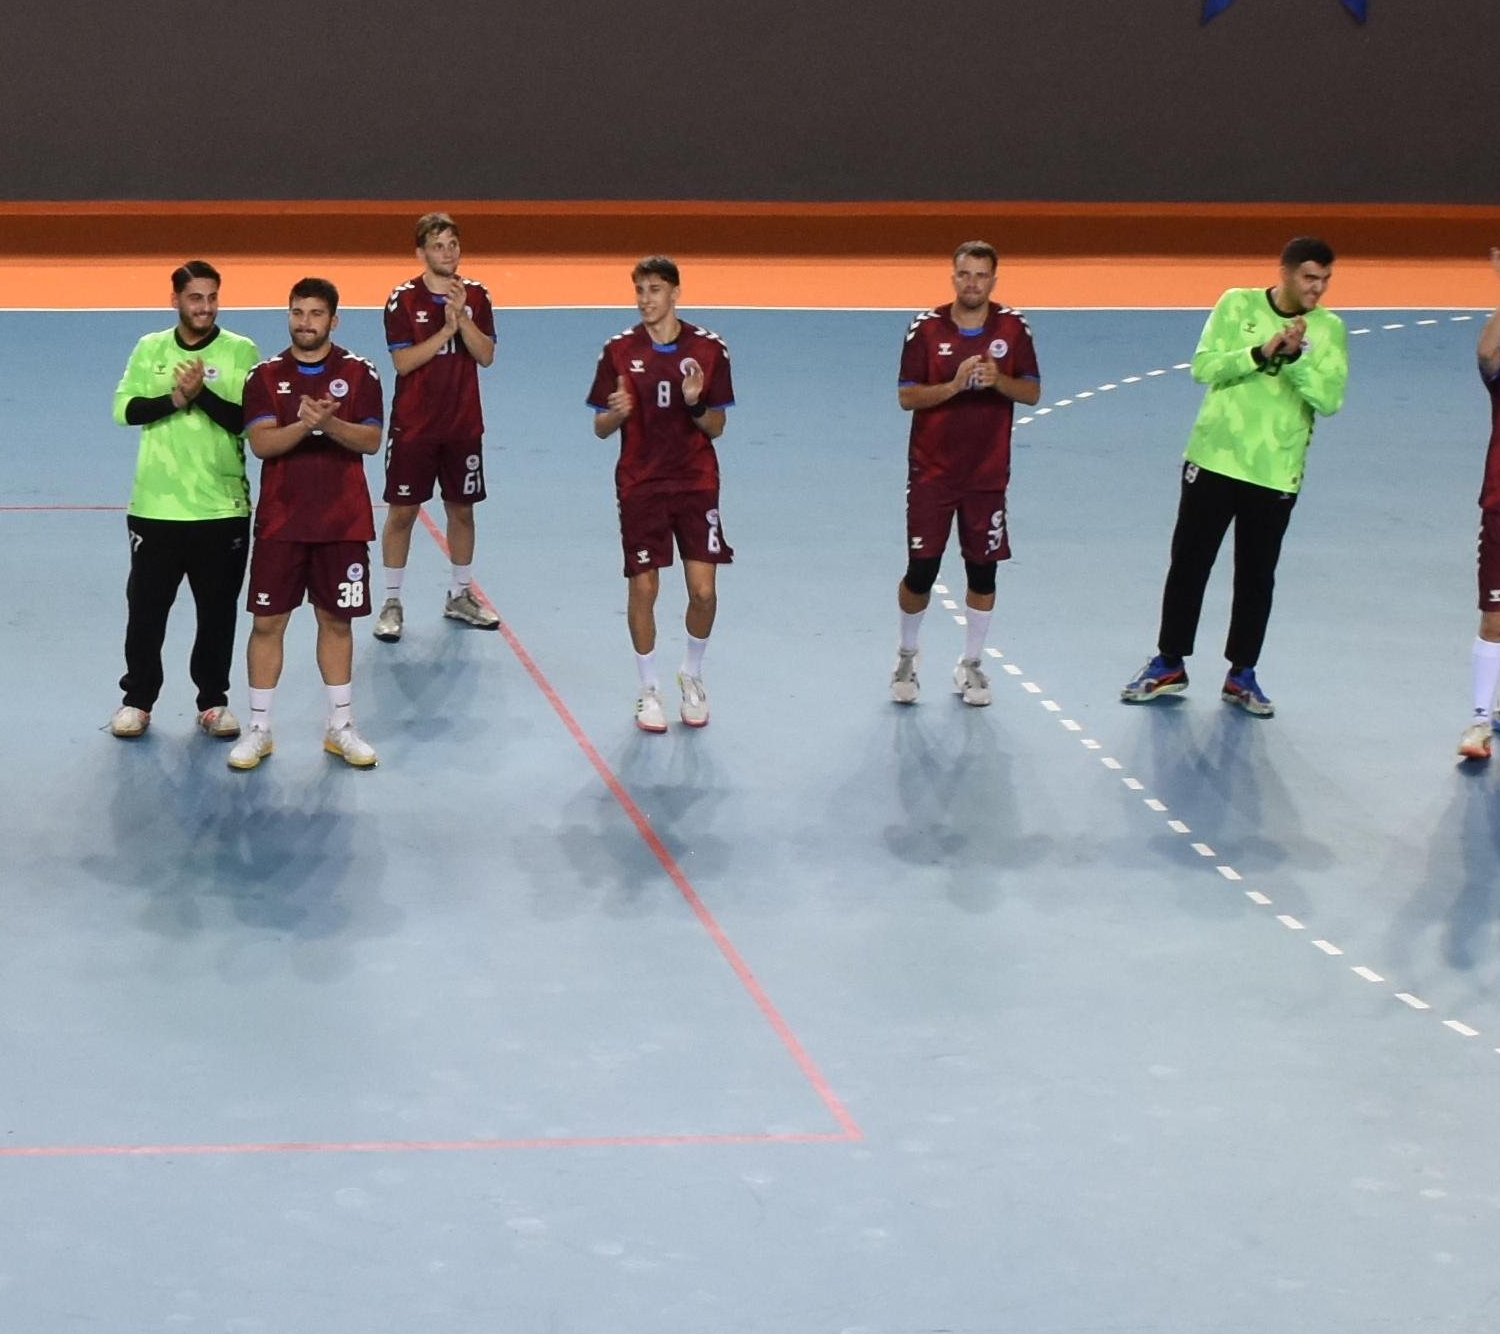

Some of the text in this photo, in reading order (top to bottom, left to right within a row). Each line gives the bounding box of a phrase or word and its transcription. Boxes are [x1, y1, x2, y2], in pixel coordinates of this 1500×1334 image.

[657, 380, 671, 408] 8
[463, 470, 482, 495] 61
[336, 580, 362, 609] 38
